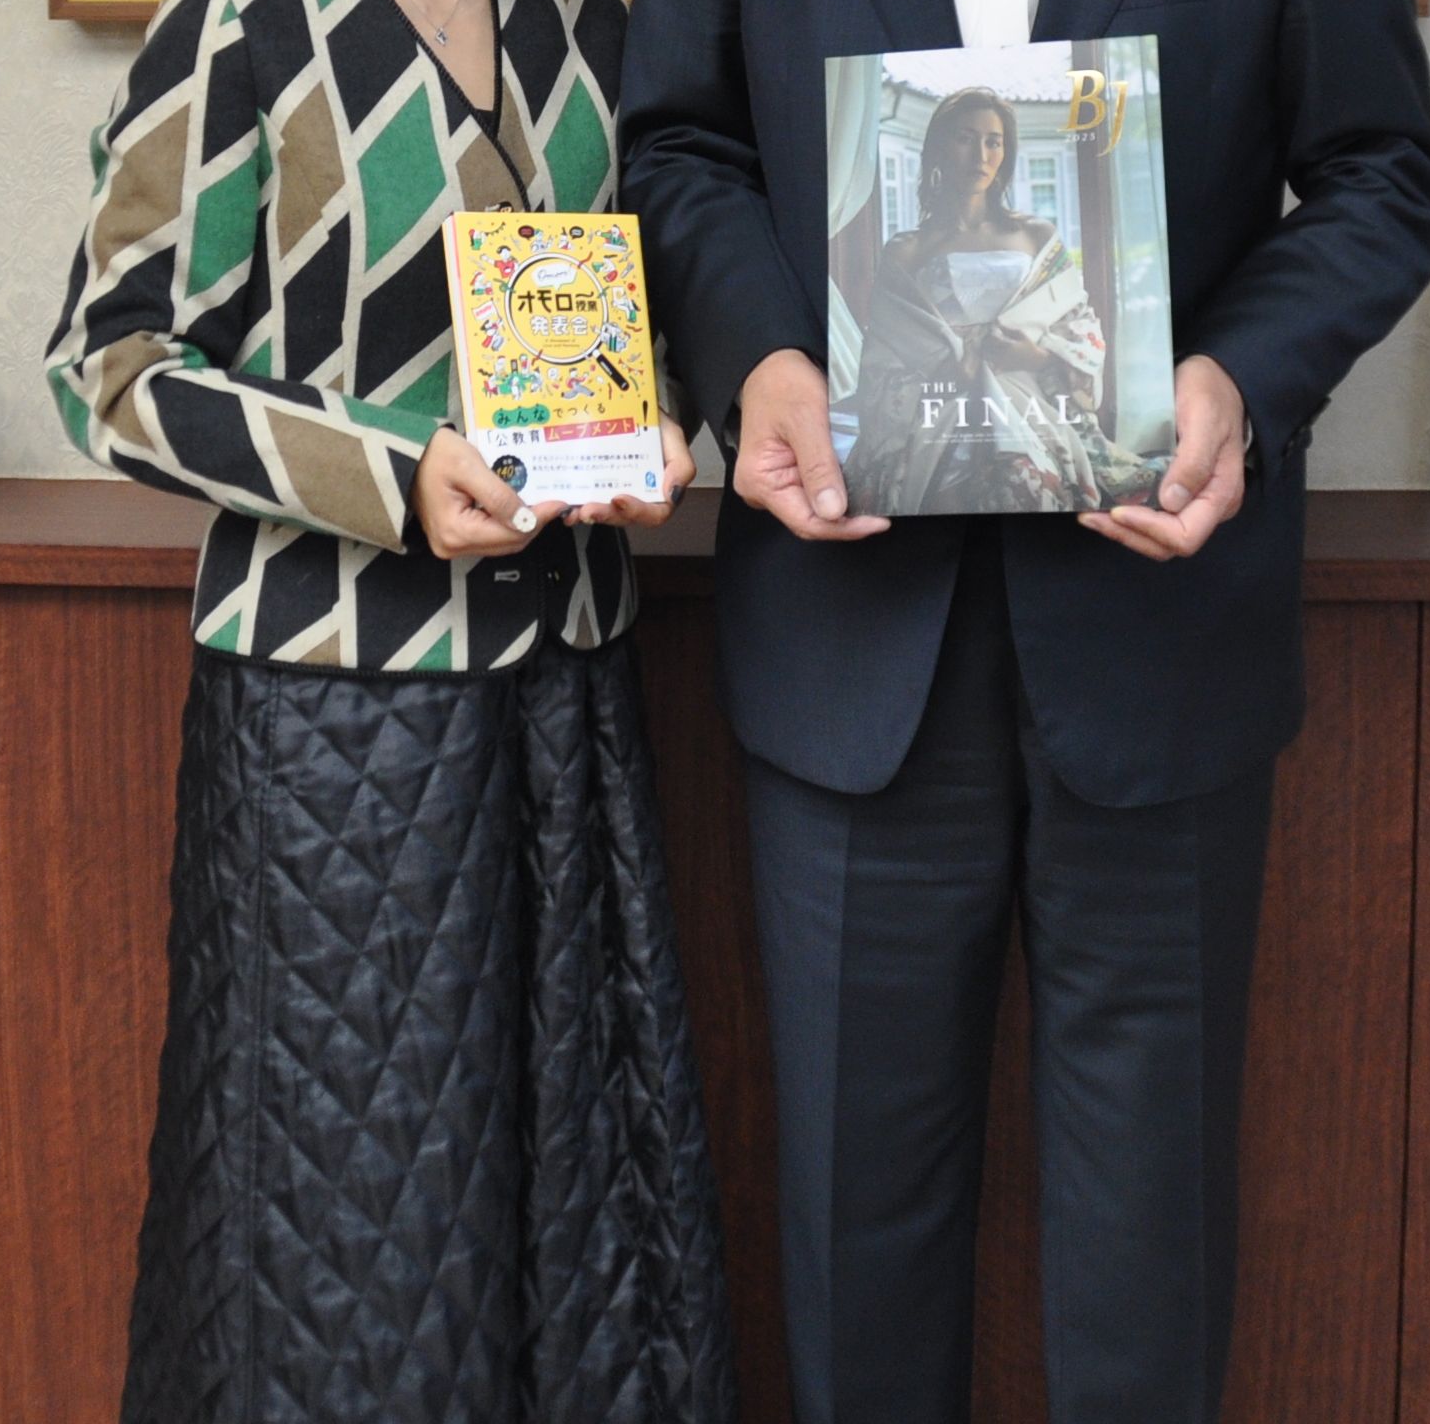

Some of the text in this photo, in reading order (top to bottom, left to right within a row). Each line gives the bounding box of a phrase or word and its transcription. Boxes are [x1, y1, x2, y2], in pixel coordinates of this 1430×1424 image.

[530, 316, 589, 336] 発表会
[921, 382, 957, 394] THE
[497, 402, 606, 423] みんなでつくる
[921, 394, 1082, 428] FINAL
